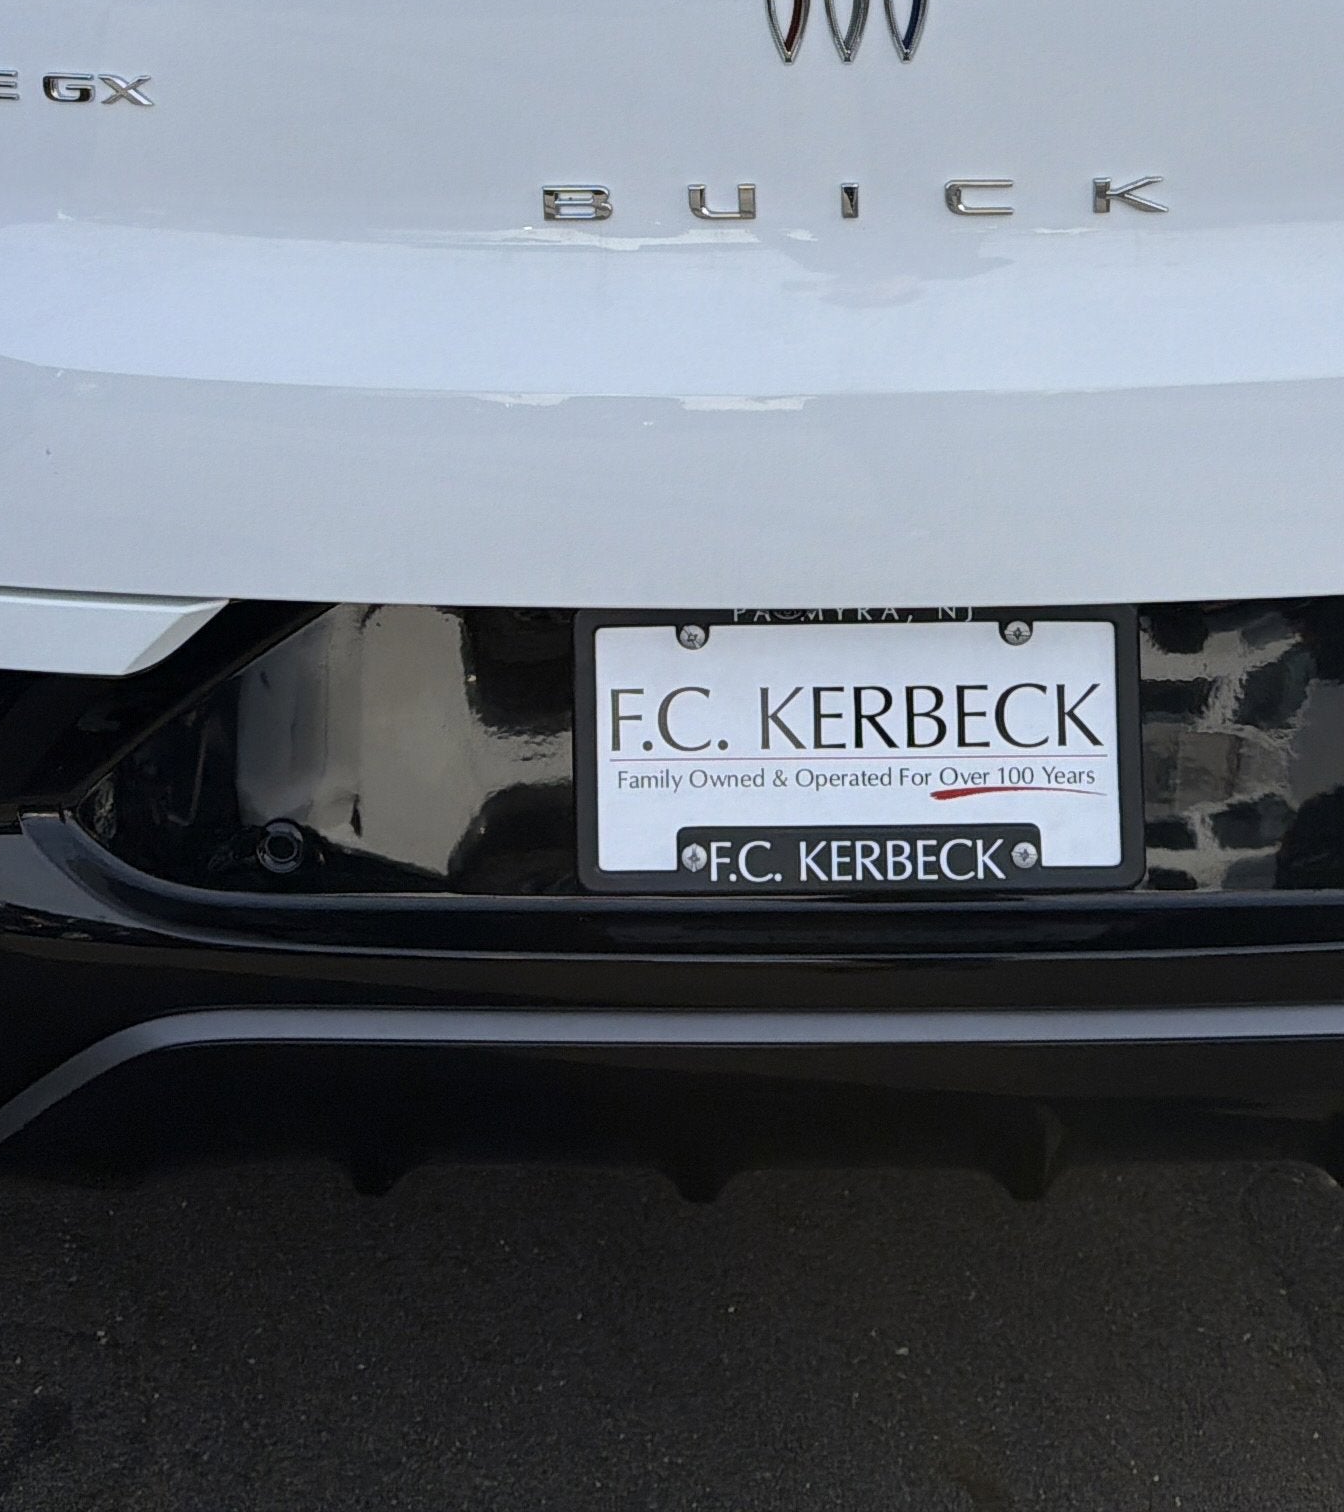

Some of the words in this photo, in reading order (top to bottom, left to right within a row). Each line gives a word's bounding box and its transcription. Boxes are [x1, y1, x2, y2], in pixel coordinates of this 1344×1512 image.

[41, 71, 155, 107] GX
[542, 175, 1168, 221] BUICK
[733, 607, 913, 624] PAMYRA,
[938, 606, 974, 623] NJ
[610, 686, 729, 752] F.C.
[759, 683, 1104, 750] KERBECK
[617, 768, 683, 793] Family
[689, 767, 766, 789] Owned
[772, 768, 788, 788] &
[795, 767, 892, 791] Operated
[899, 767, 932, 786] For
[939, 766, 990, 785] Over
[997, 766, 1034, 786] 100
[1042, 765, 1096, 785] Years
[709, 840, 783, 883] F.C.
[799, 838, 1007, 881] KERBECK
